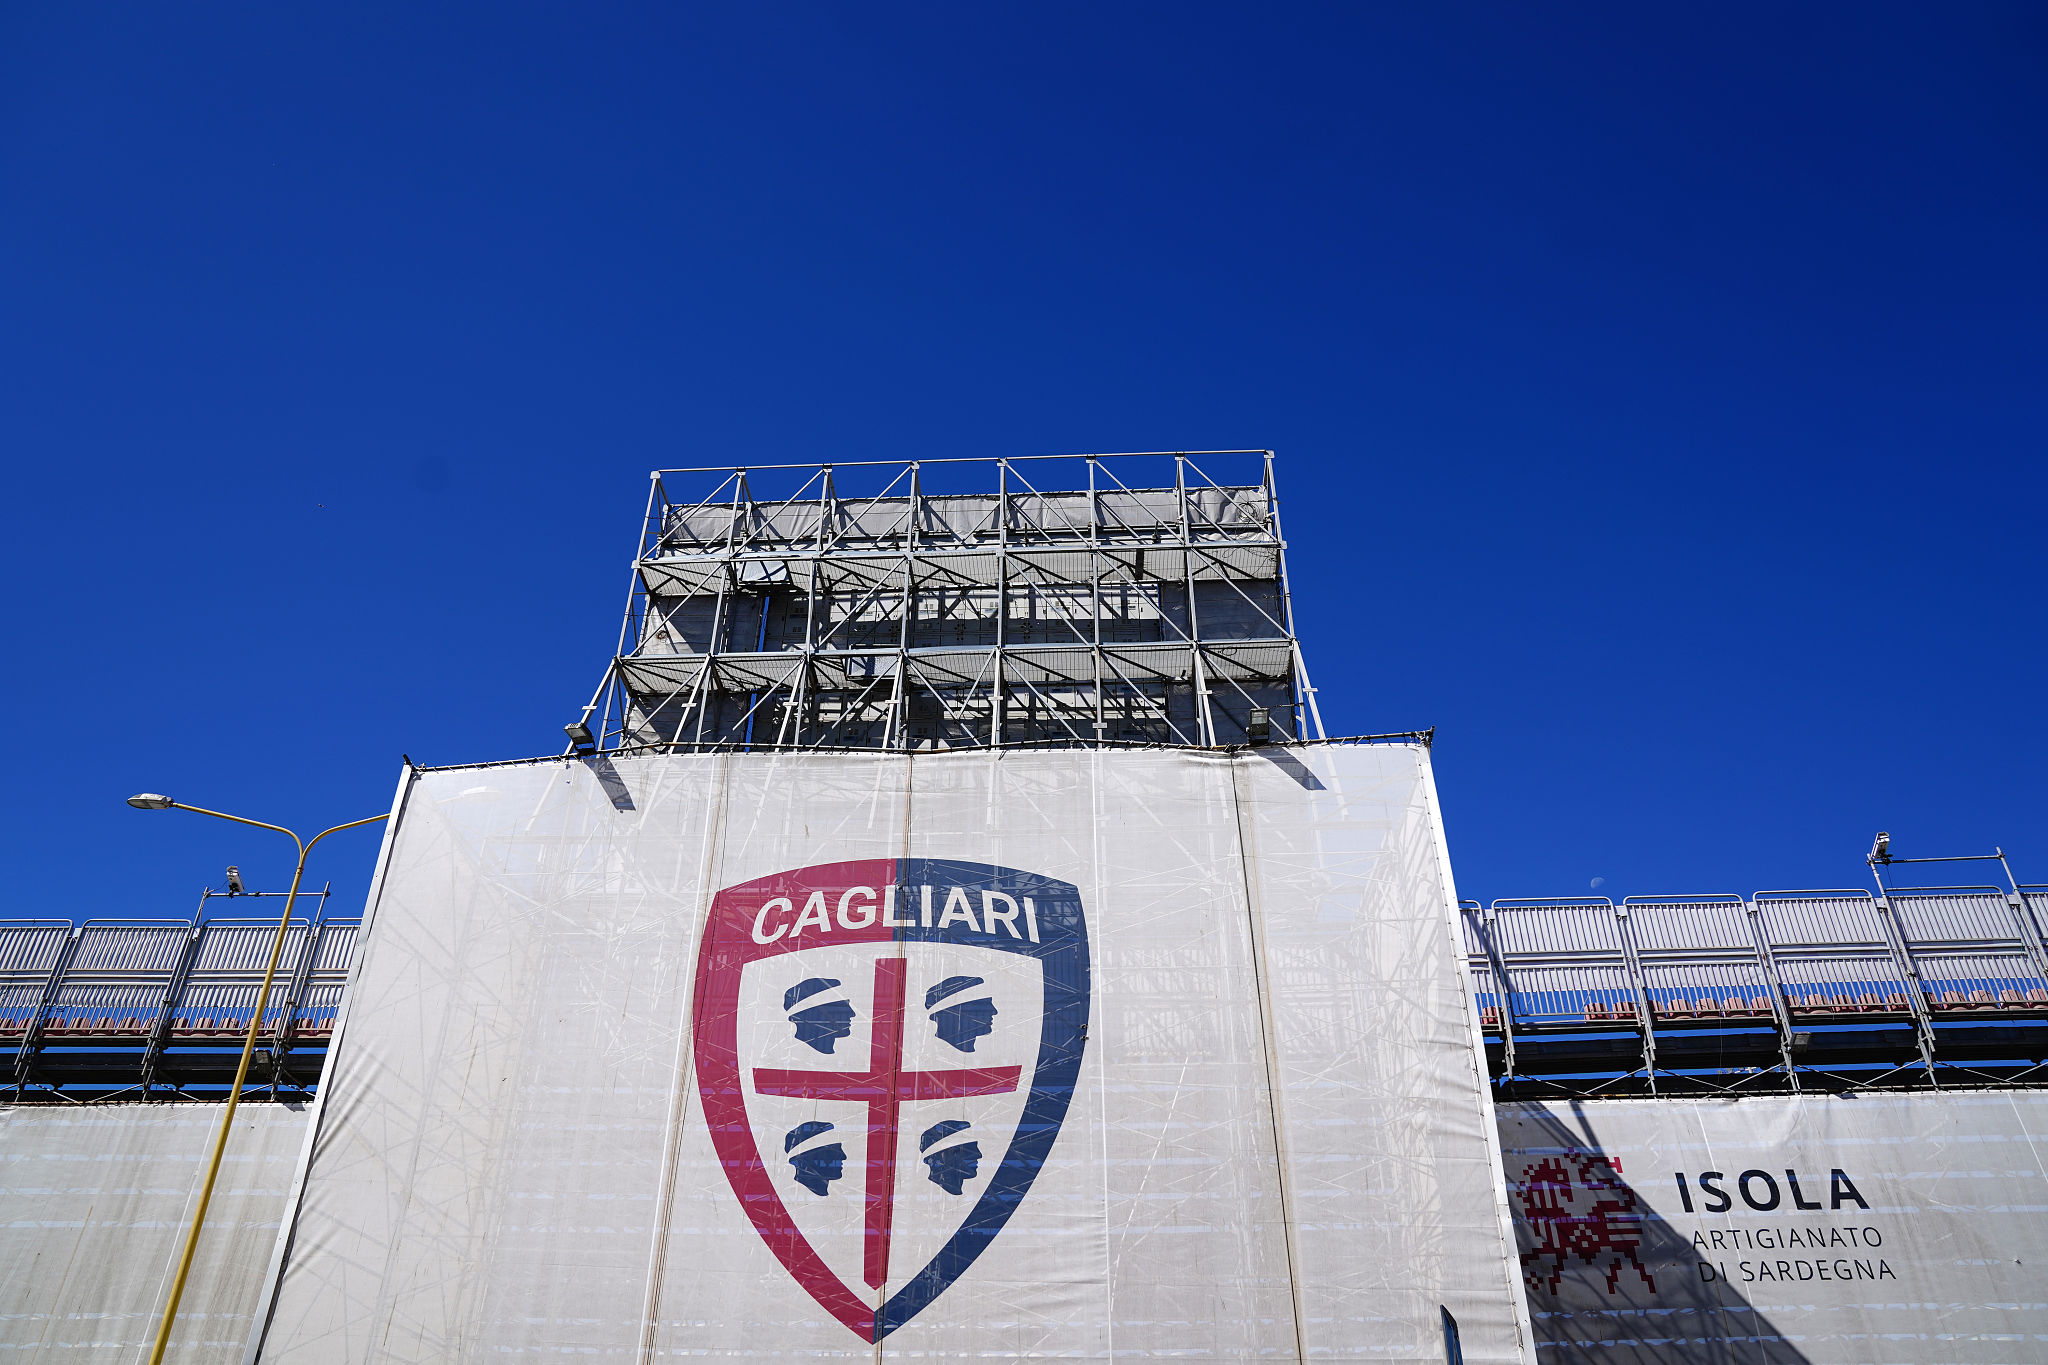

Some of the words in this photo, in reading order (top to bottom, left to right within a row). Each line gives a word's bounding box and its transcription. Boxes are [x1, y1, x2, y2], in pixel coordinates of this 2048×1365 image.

[751, 884, 1041, 945] CAGLIARI
[1675, 1168, 1871, 1213] ISOLA
[1692, 1226, 1882, 1250] ARTIGIANATO
[1698, 1261, 1728, 1283] DI
[1739, 1259, 1896, 1282] SARDEGNA
